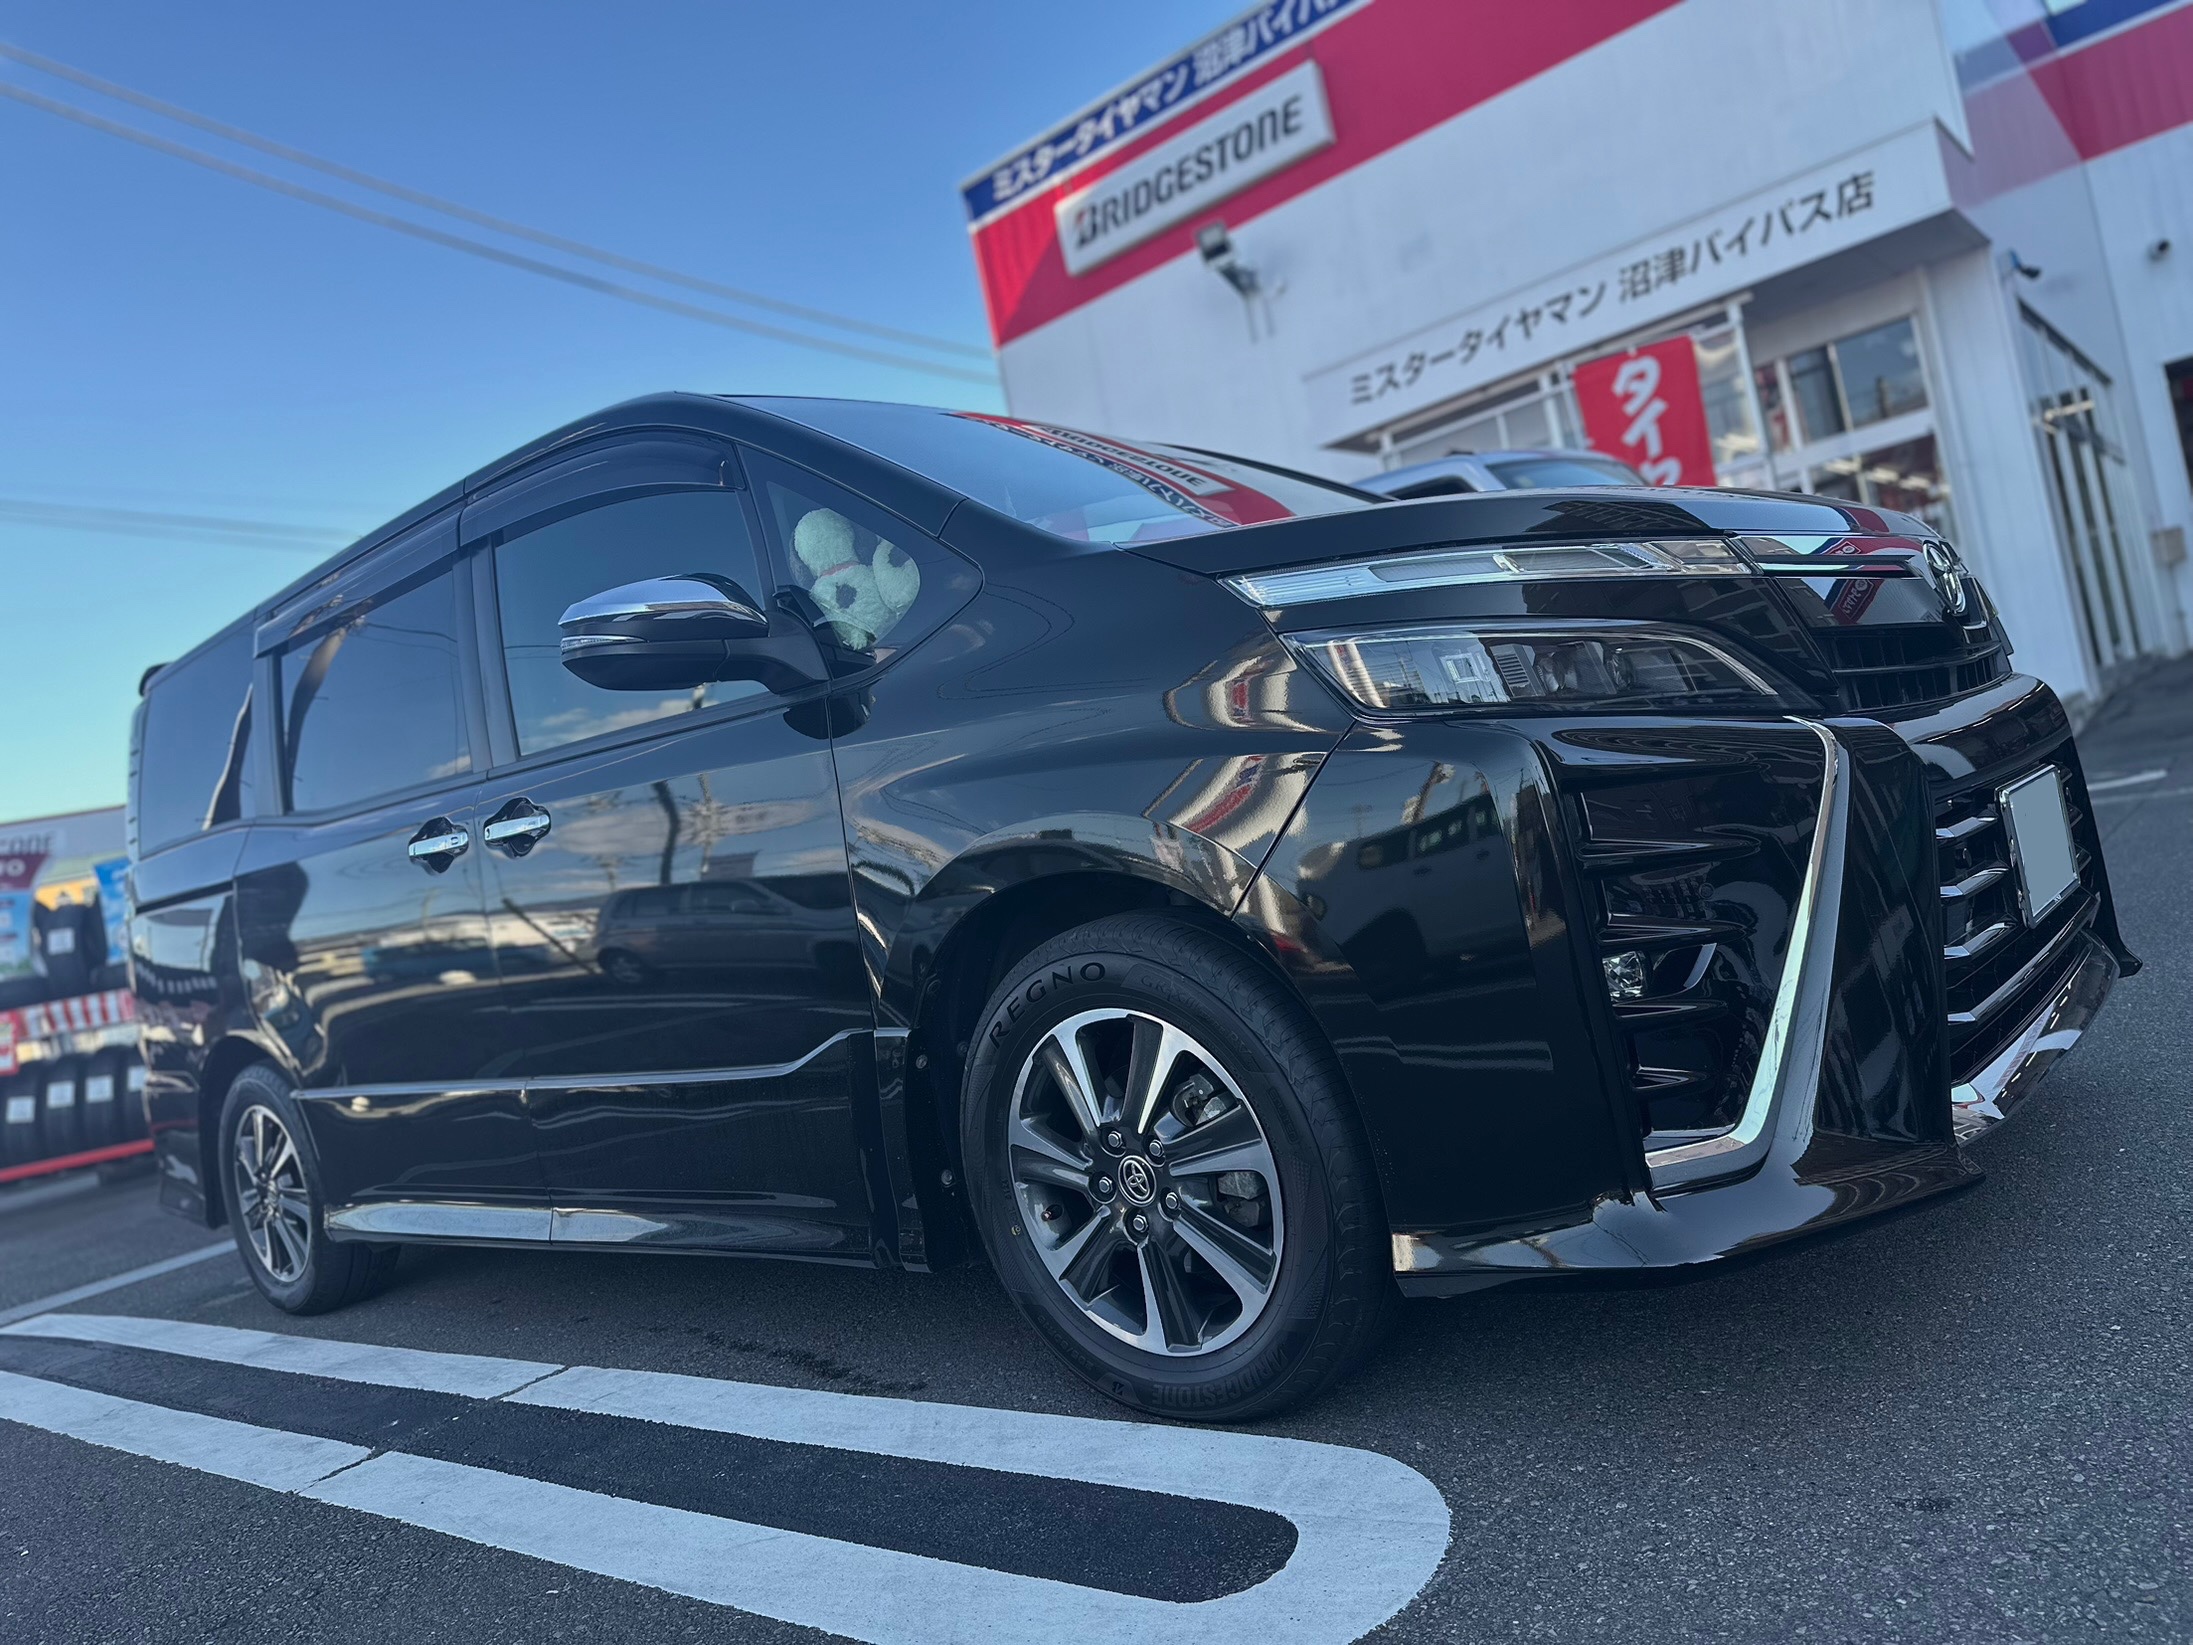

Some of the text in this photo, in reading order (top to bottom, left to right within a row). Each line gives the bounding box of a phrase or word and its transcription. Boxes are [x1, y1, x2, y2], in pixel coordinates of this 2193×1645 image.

[991, 64, 1189, 201] ミスタータイヤマン
[1074, 95, 1304, 250] BRIDGESTONE
[1350, 170, 1875, 405] ミスタータイヤマン 沼津バイパス店
[988, 961, 1106, 1049] REGNO
